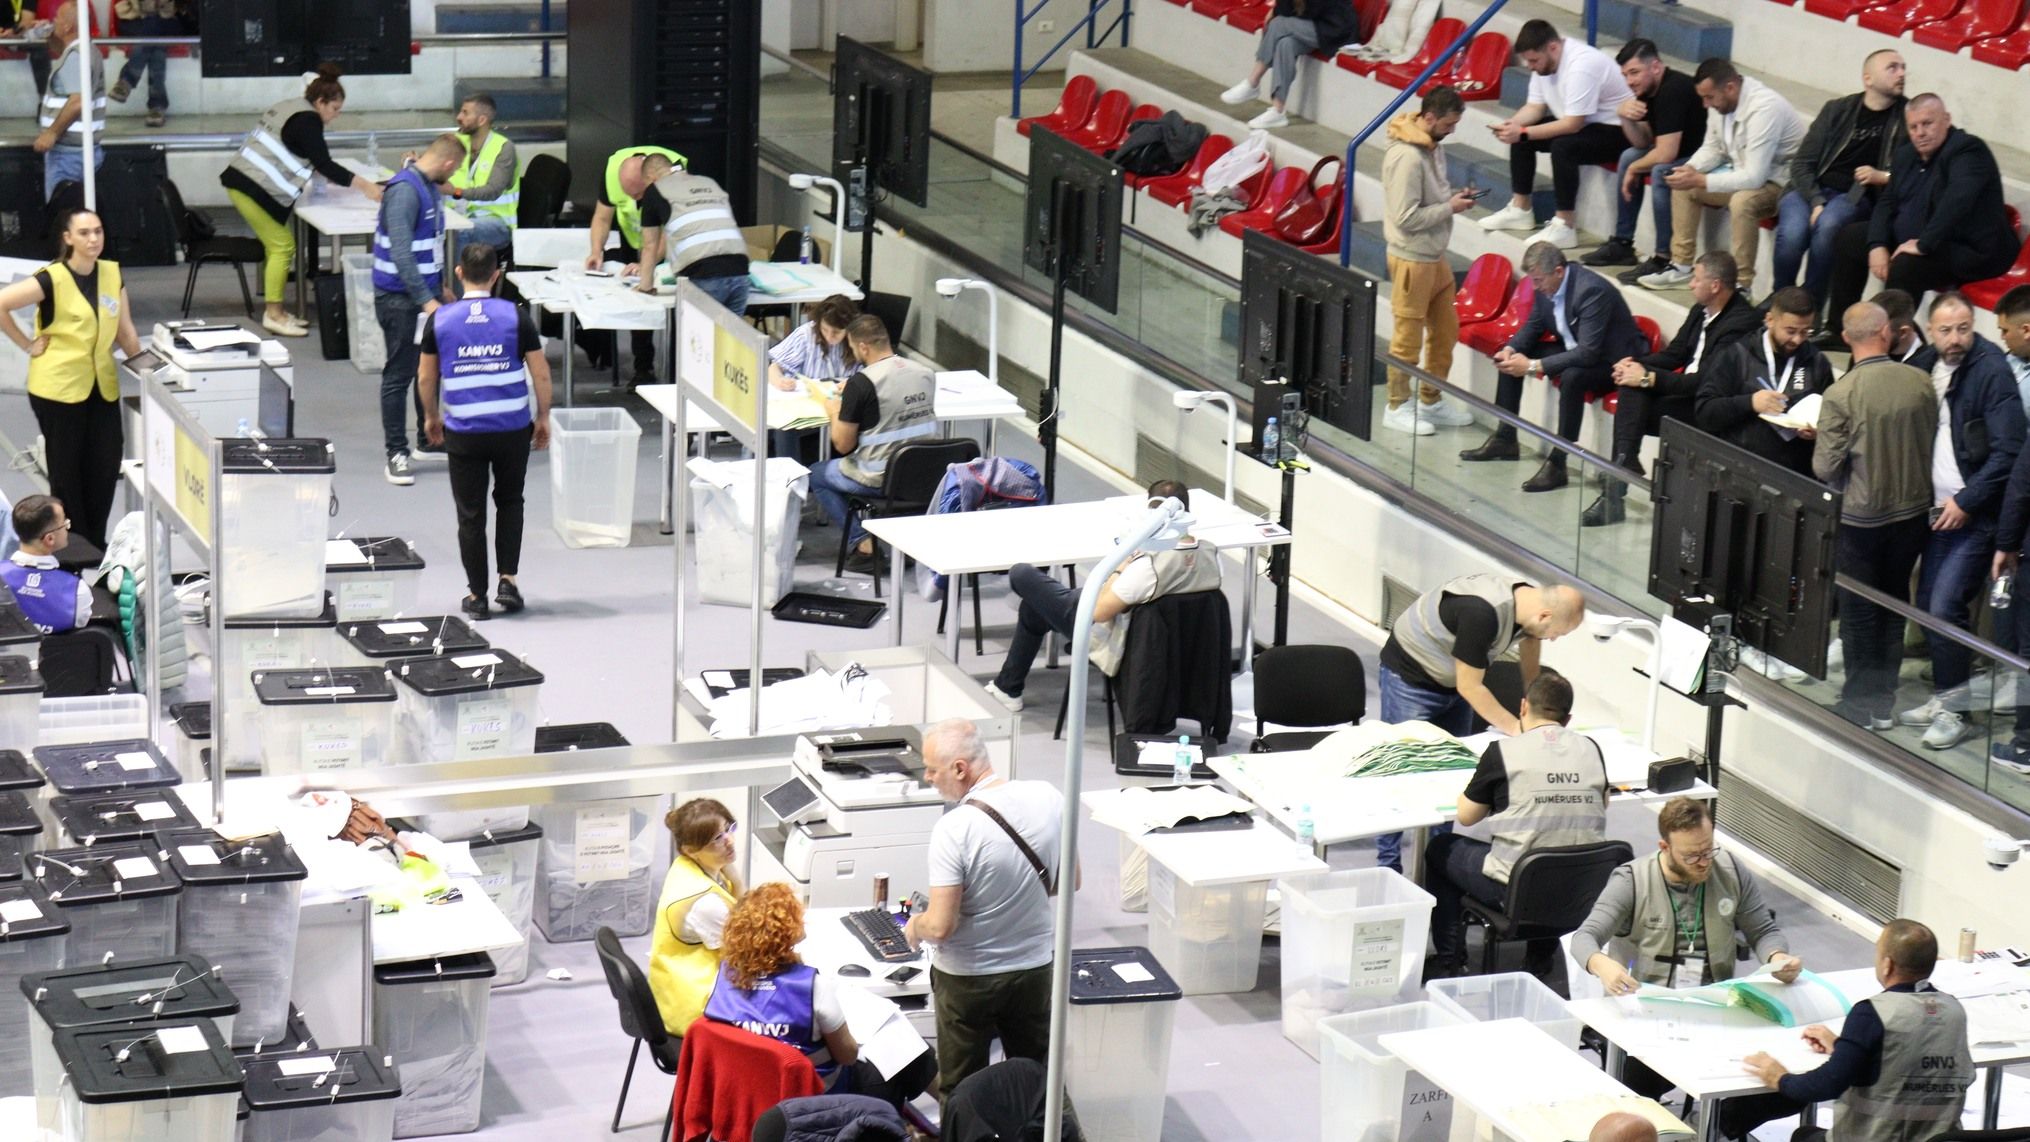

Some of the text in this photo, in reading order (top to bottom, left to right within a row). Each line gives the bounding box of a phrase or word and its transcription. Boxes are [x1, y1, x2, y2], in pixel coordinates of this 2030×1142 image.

[458, 344, 503, 358] KANVVJ
[724, 359, 749, 394] KUKËS
[1793, 367, 1805, 390] NIKE
[183, 465, 205, 505] VLORË
[1547, 772, 1580, 784] GNVJ
[1534, 793, 1582, 805] NUMËRUES
[1921, 1055, 1956, 1070] GNVJ
[1422, 1110, 1433, 1122] A
